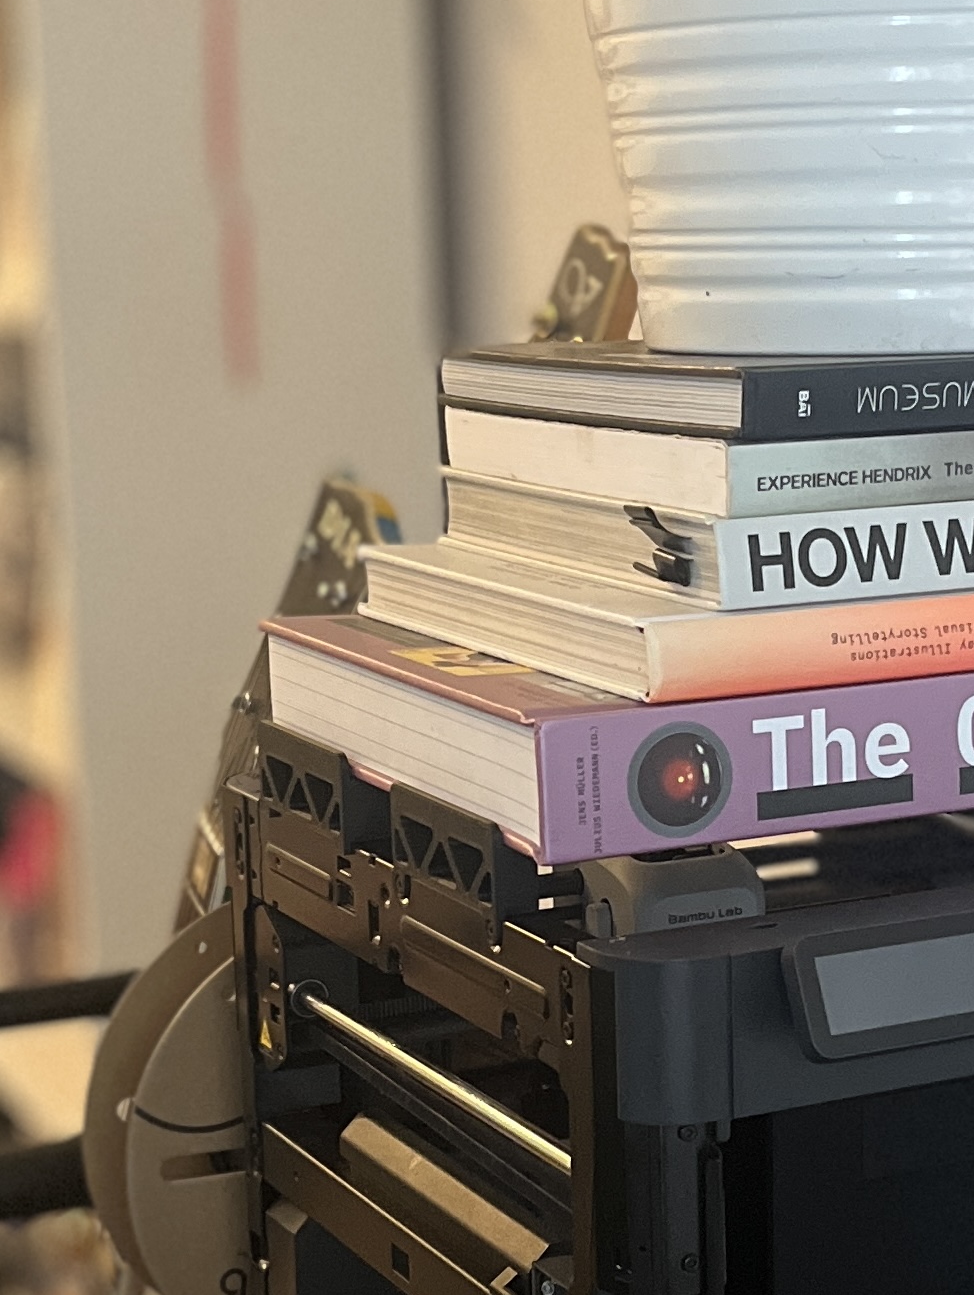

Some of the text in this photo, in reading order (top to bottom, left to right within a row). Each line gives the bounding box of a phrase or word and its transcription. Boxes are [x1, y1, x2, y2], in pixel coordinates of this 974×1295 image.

[756, 469, 859, 493] EXPERIENCE
[862, 464, 932, 485] HENDRIX
[944, 462, 974, 477] The
[747, 521, 908, 593] HOW
[831, 627, 928, 646] Storytelling
[850, 641, 952, 662] Illustrations
[752, 708, 911, 791] The
[667, 906, 743, 925] Bambu Lab
